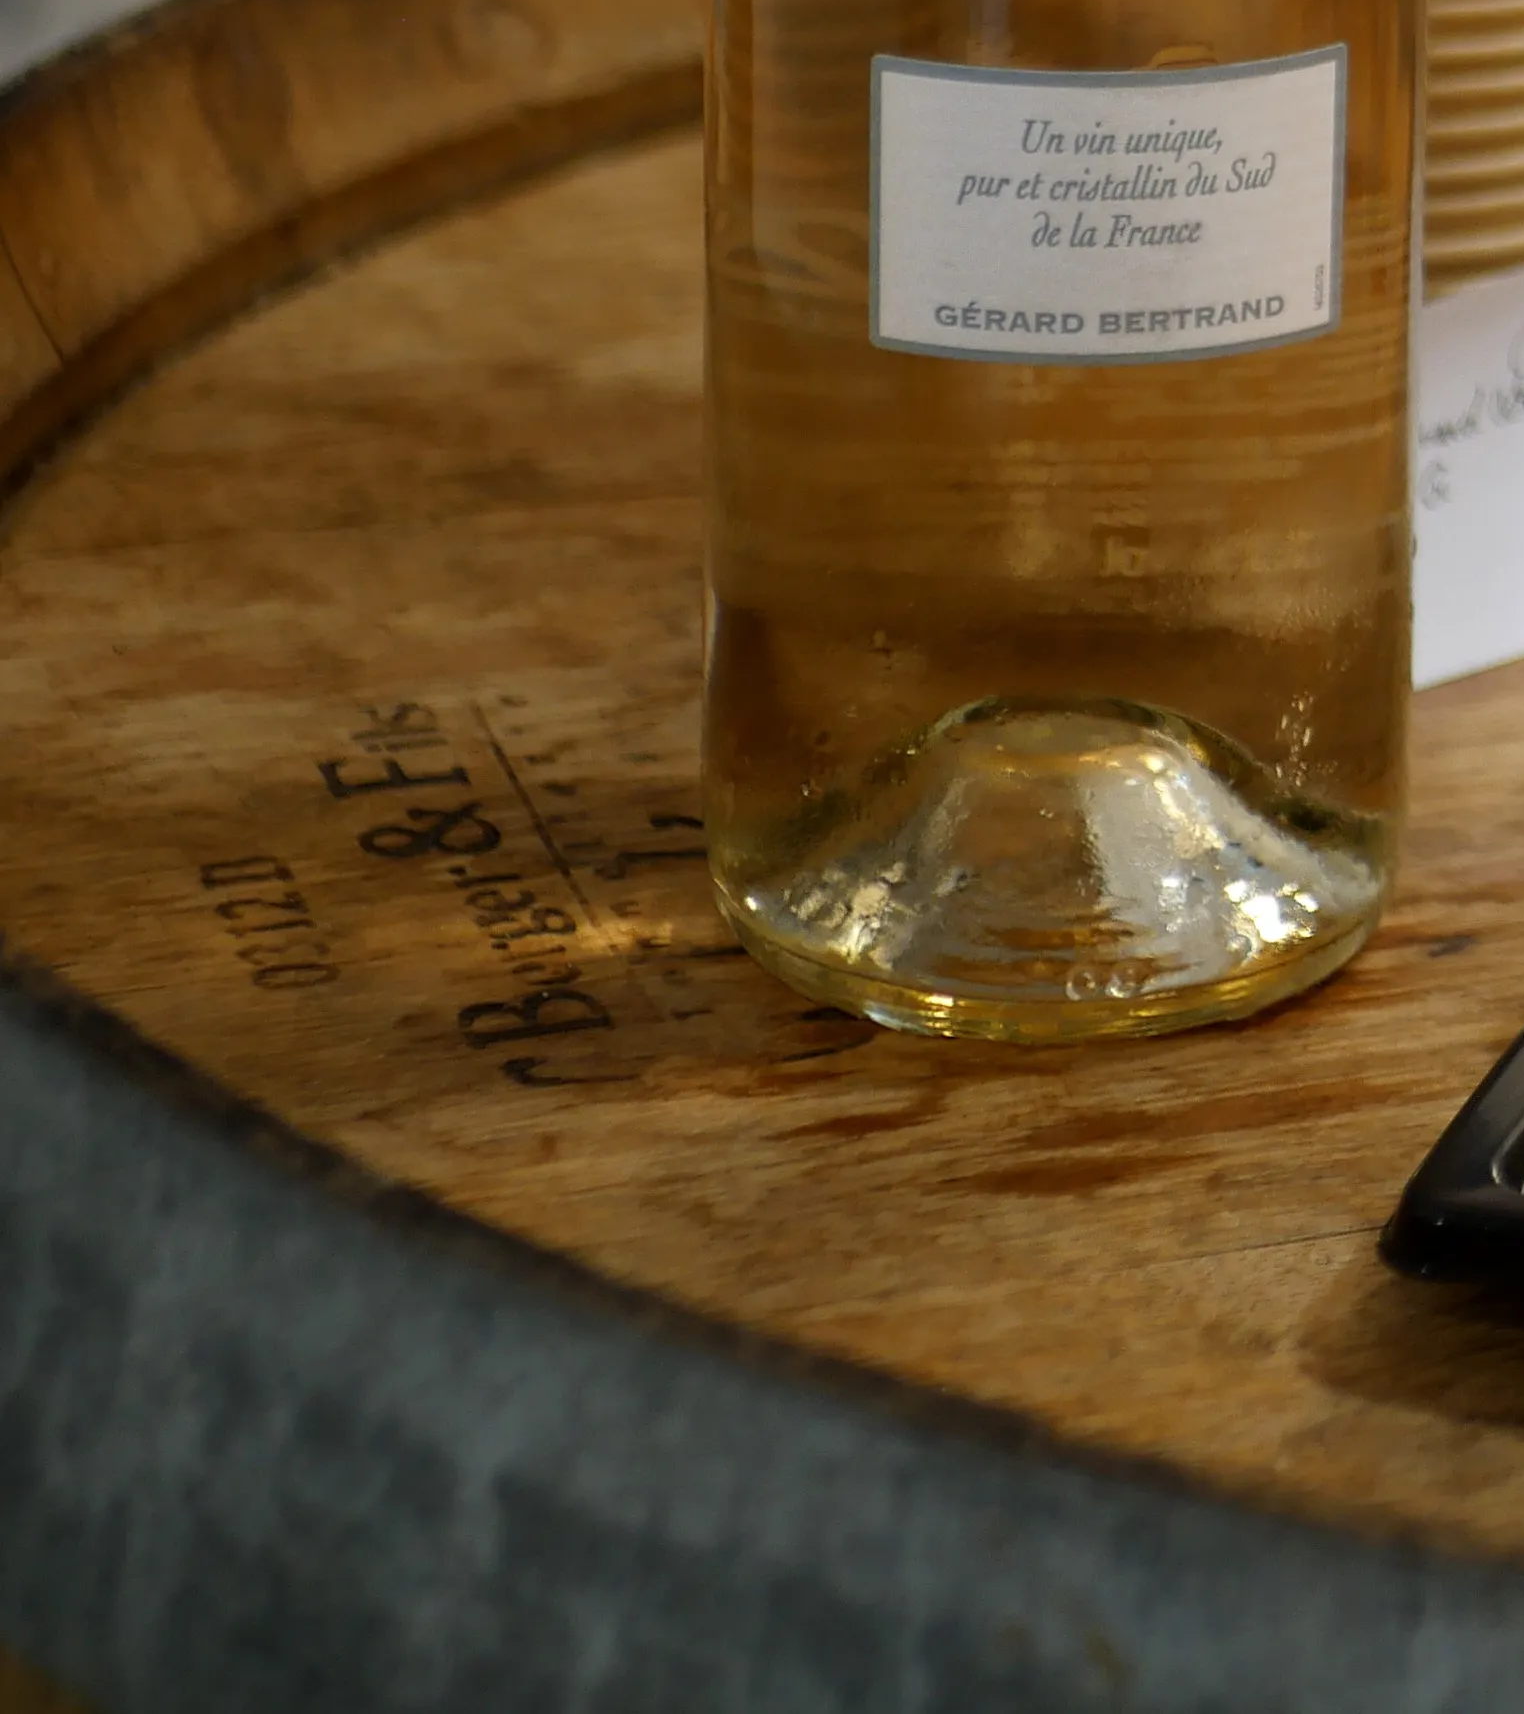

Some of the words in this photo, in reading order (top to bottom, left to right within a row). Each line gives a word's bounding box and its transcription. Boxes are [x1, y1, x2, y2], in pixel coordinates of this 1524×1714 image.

[1021, 119, 1065, 154] Un
[1074, 122, 1116, 154] vin
[1124, 119, 1224, 163] unique,
[956, 174, 1014, 205] pur
[1016, 173, 1043, 200] et
[1049, 164, 1178, 201] cristallin
[1185, 161, 1219, 197] du
[1225, 151, 1277, 193] Sud
[1030, 211, 1062, 248] de
[1068, 212, 1098, 247] la
[1104, 214, 1204, 248] France
[933, 301, 1085, 334] GÉRARD
[1098, 294, 1286, 334] BERTRAND
